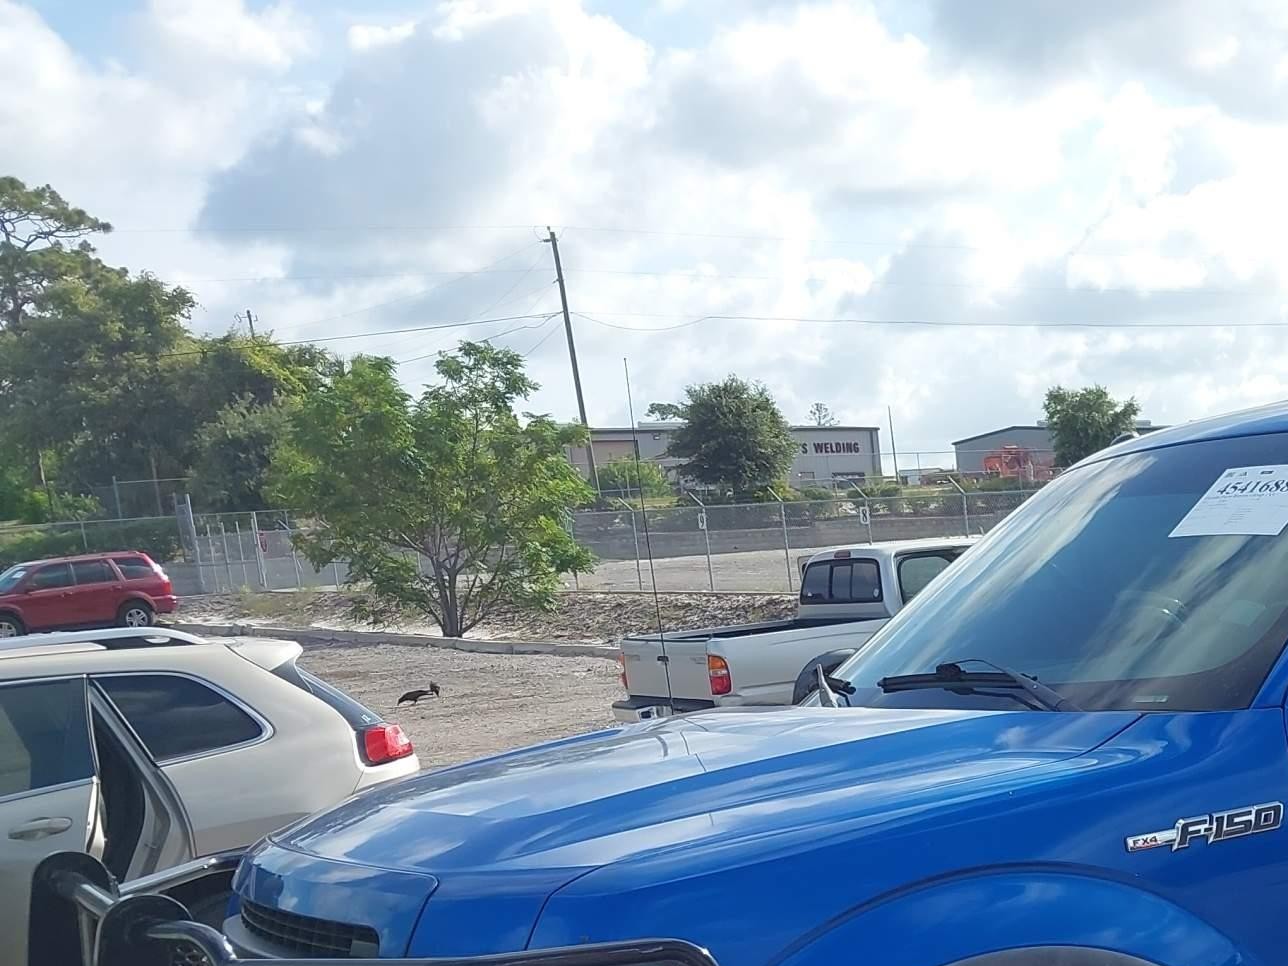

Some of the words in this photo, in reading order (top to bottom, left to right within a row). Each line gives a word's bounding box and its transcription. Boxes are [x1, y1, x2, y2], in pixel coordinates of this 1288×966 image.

[813, 442, 860, 454] WELDING
[1132, 835, 1158, 848] FX4
[1172, 801, 1284, 852] F-150
